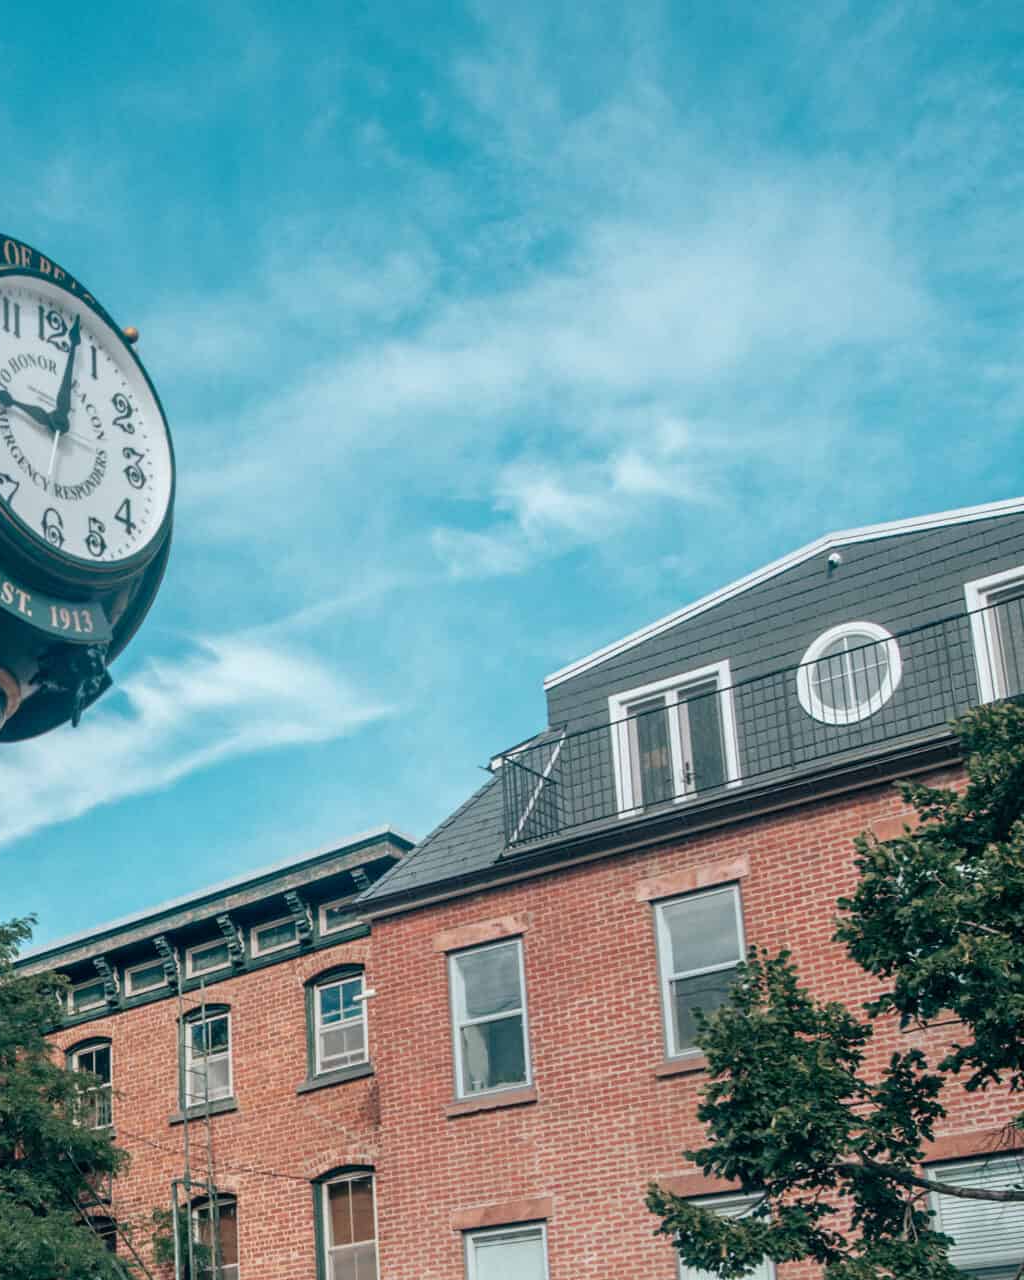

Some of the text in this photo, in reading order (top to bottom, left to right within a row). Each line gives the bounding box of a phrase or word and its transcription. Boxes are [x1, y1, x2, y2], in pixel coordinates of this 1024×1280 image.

[4, 239, 32, 268] OF
[3, 296, 21, 338] 11
[38, 304, 70, 353] 12
[90, 345, 98, 380] 1
[8, 353, 58, 375] HONOR
[70, 379, 105, 440] ACON
[112, 392, 136, 435] 2
[54, 448, 108, 501] RESPONDERS
[122, 446, 147, 490] 3
[41, 507, 65, 549] 6
[85, 516, 107, 557] 5
[114, 498, 137, 536] 4
[49, 605, 94, 633] 1913
